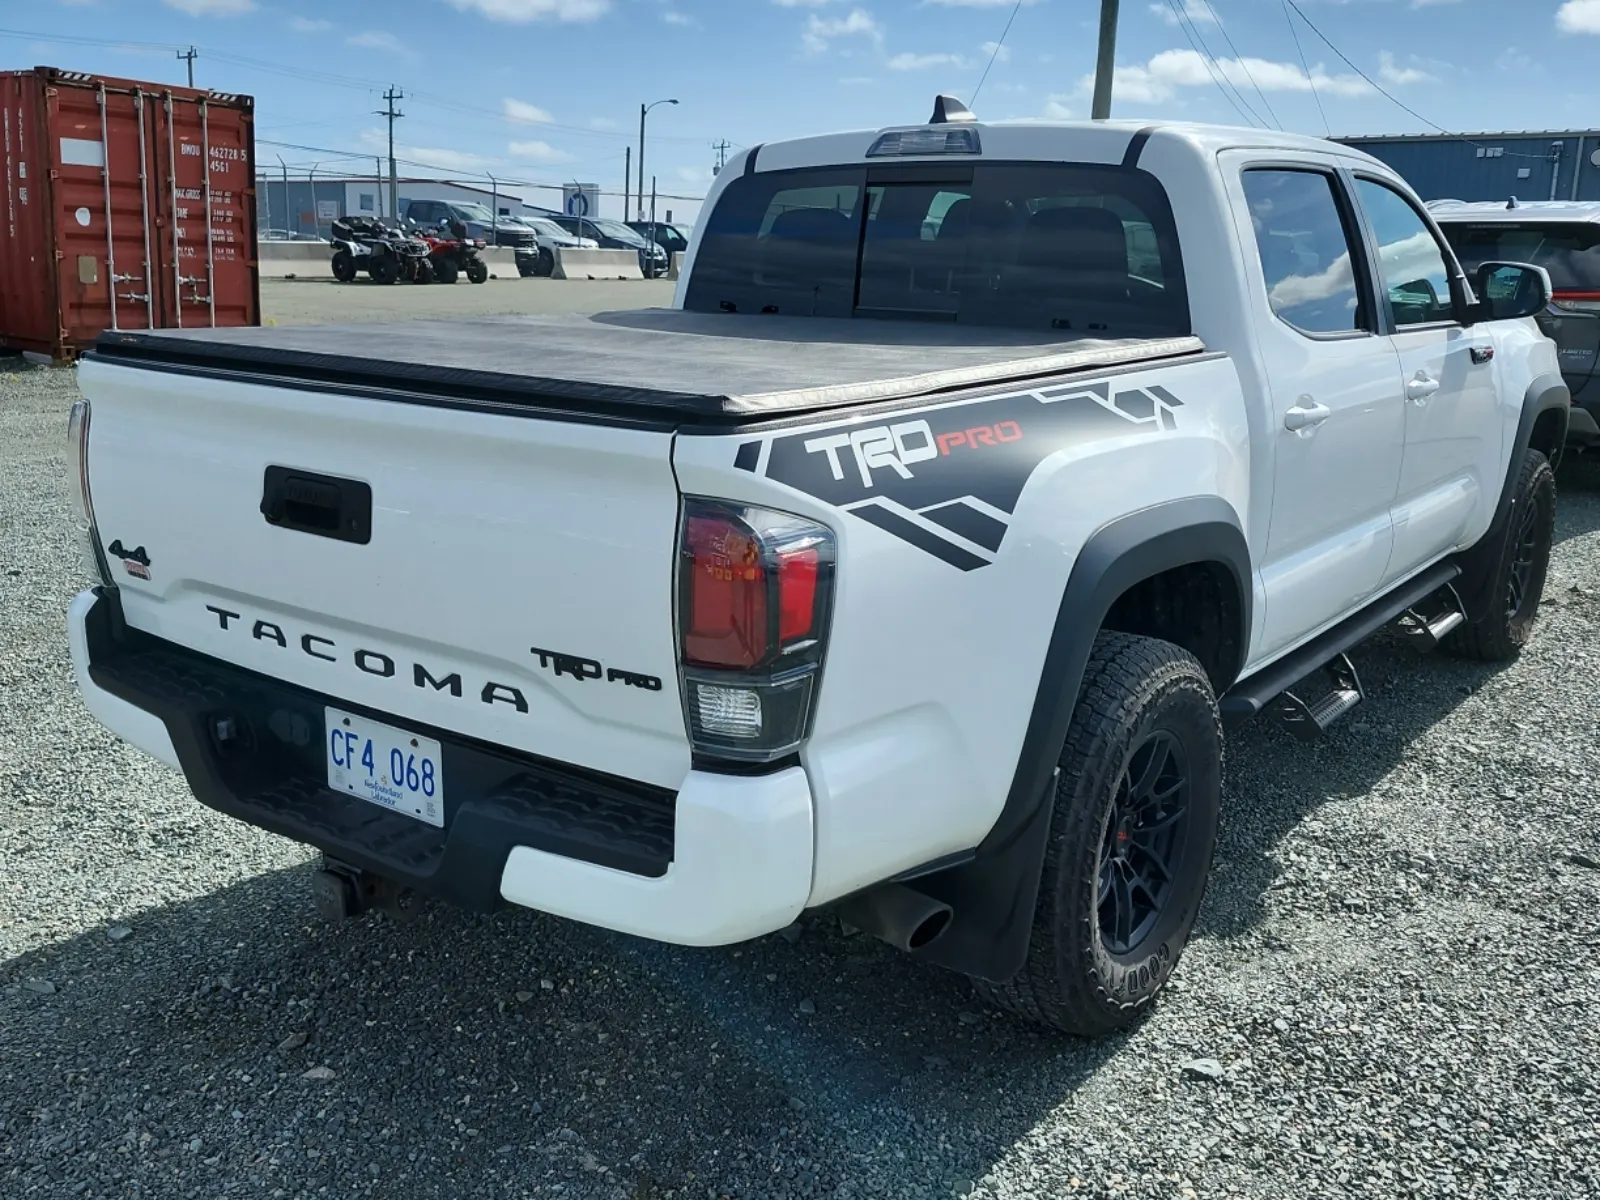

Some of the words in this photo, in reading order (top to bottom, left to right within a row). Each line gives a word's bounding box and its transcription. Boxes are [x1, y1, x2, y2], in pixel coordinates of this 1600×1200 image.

[804, 419, 937, 488] TRD
[936, 420, 1023, 457] PRO
[205, 604, 529, 714] TACOMA
[530, 647, 603, 682] TRD
[606, 668, 662, 691] PRO
[331, 728, 375, 777] CF4
[390, 747, 435, 797] 068
